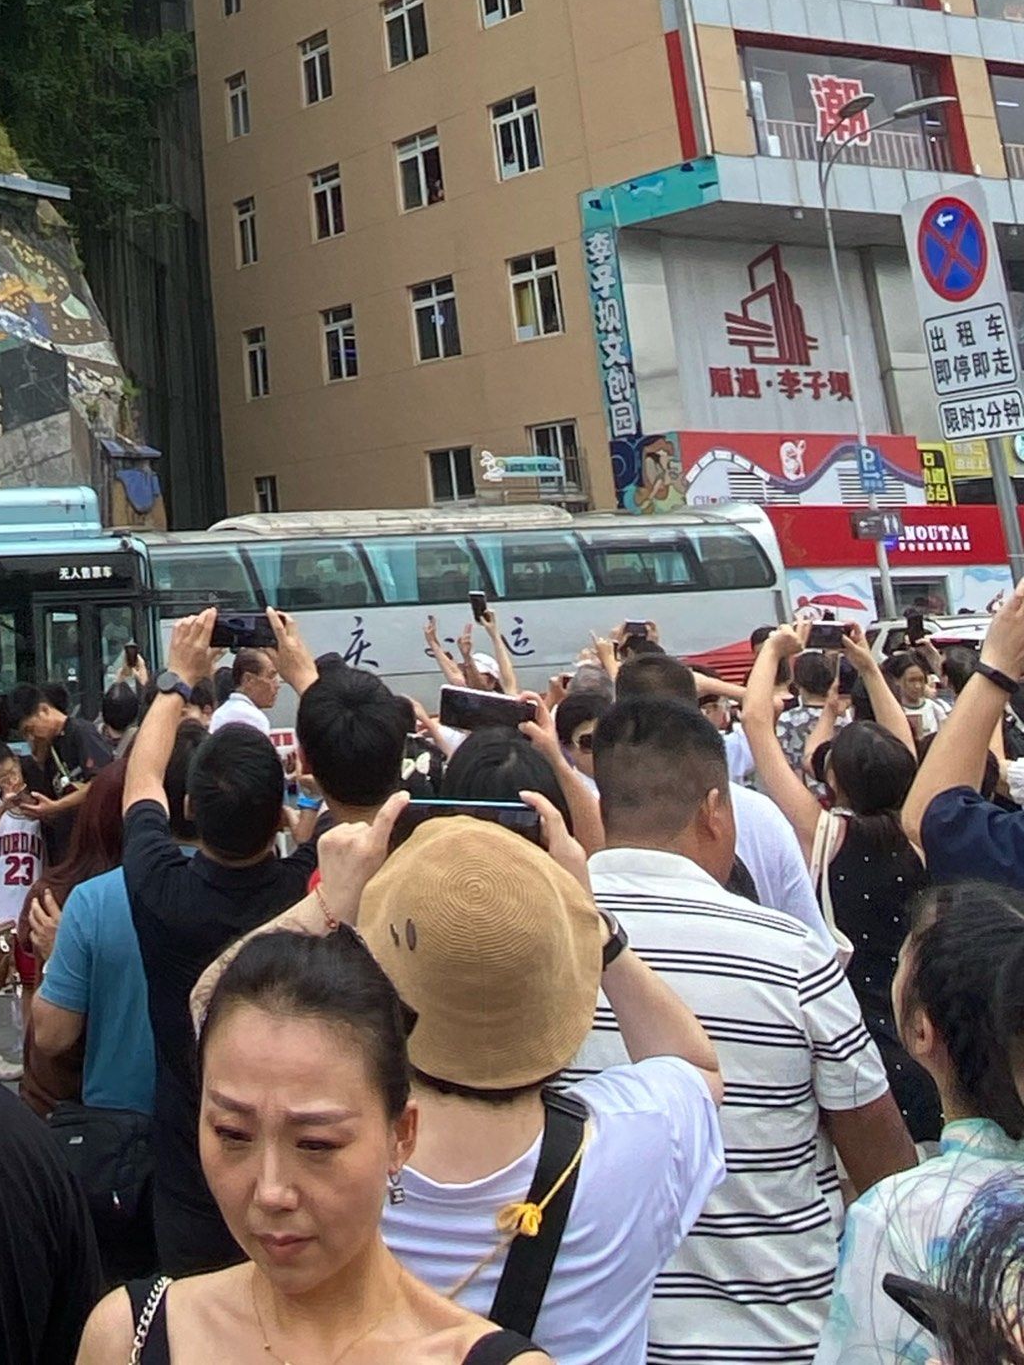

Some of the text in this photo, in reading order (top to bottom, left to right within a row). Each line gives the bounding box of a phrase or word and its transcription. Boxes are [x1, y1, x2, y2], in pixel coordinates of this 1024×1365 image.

[810, 75, 871, 146] 潮
[586, 232, 637, 437] 李子坝文创园
[929, 313, 1005, 353] 出租车
[934, 347, 1012, 386] 即停即走
[943, 398, 1021, 434] 限时3分钟
[4, 855, 34, 886] 23
